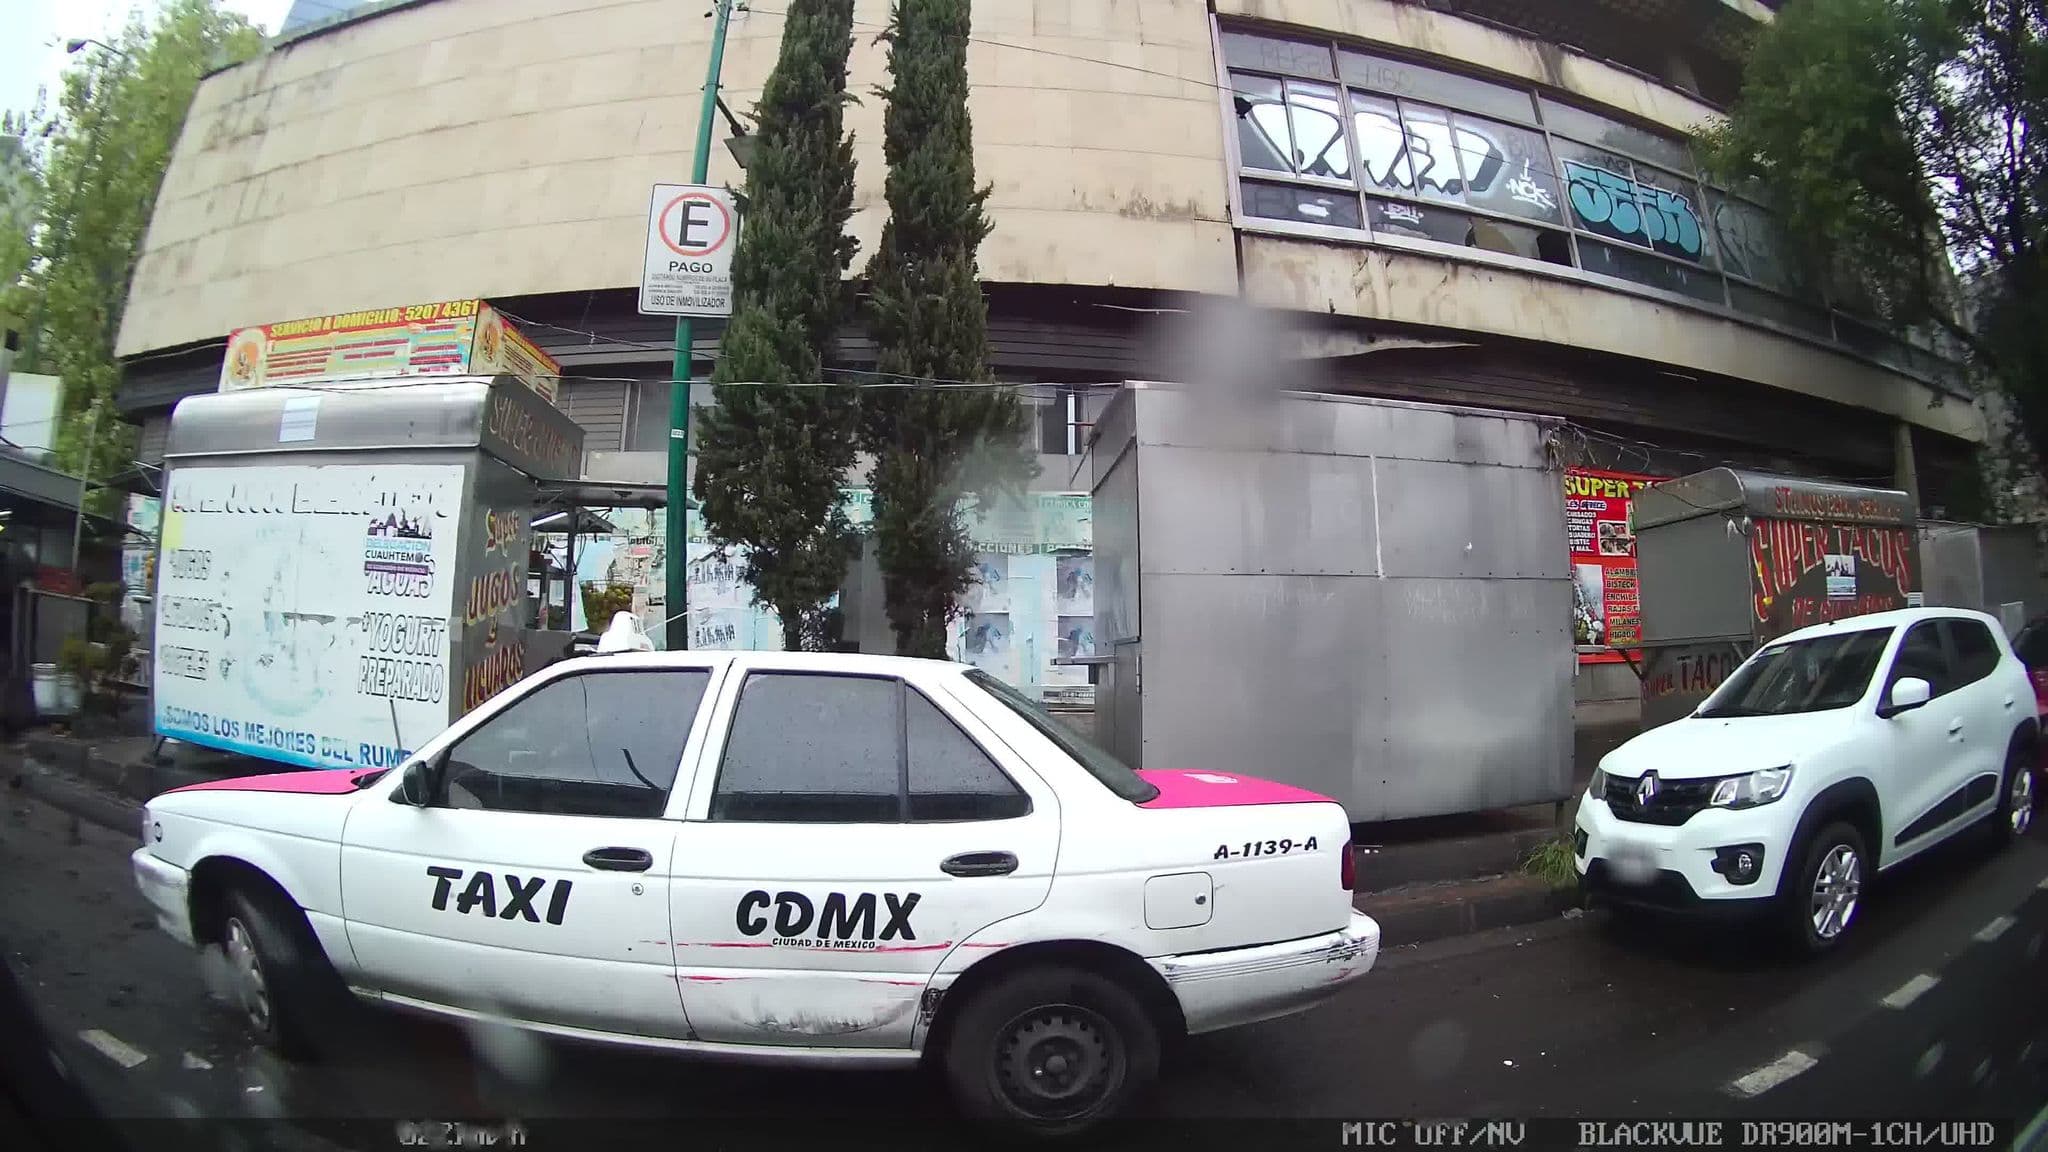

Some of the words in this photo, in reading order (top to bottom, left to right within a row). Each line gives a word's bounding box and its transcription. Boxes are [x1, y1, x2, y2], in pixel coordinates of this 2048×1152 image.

[679, 200, 710, 247] E
[669, 261, 713, 273] PAGO
[270, 317, 322, 338] SERVICIO
[334, 307, 404, 328] DOMICILIO:
[405, 304, 440, 321] 5207
[441, 300, 480, 317] 4361
[651, 295, 665, 306] USO
[666, 296, 675, 306] DE
[1564, 474, 1630, 499] SUPER
[1832, 524, 1910, 598] TACOS
[466, 561, 521, 626] JUGOS
[369, 612, 447, 658] YOGURT
[357, 656, 444, 704] PREPARADO
[164, 705, 210, 733] SOMOS
[213, 718, 241, 738] LOS
[244, 721, 316, 756] MEJORES
[320, 735, 354, 763] DEL
[1213, 836, 1318, 860] A-1139-A
[427, 866, 573, 926] TAXI
[736, 890, 922, 941] CDMX
[772, 937, 812, 947] CIUDAD
[816, 939, 830, 947] DE
[833, 940, 876, 949] MEXICO
